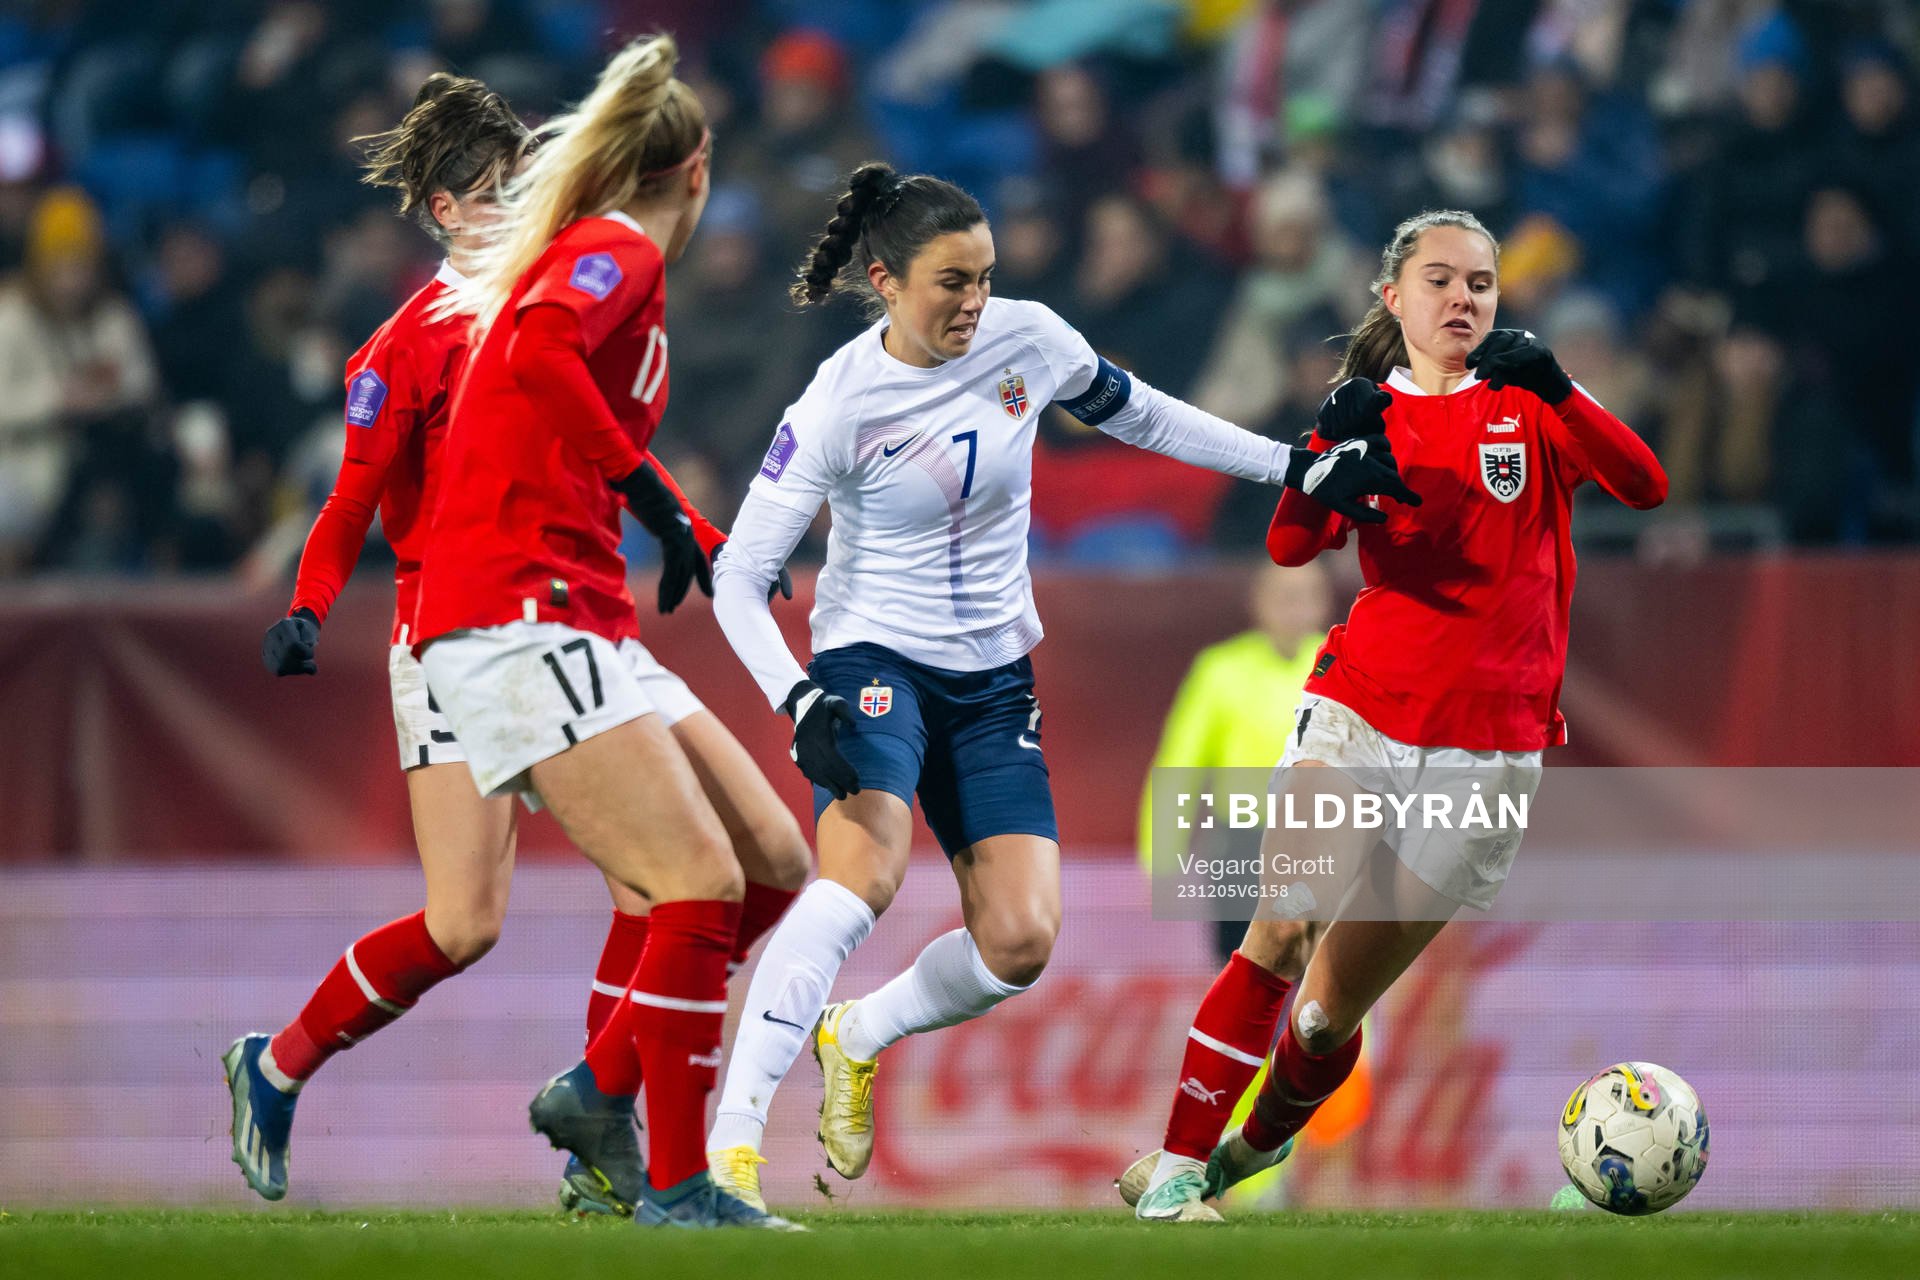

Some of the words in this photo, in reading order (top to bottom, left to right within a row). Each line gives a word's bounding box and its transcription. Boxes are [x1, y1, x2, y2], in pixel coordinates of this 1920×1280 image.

[630, 324, 668, 404] 17
[1084, 375, 1120, 413] RESPECT
[952, 429, 978, 500] 7
[542, 638, 604, 716] 17
